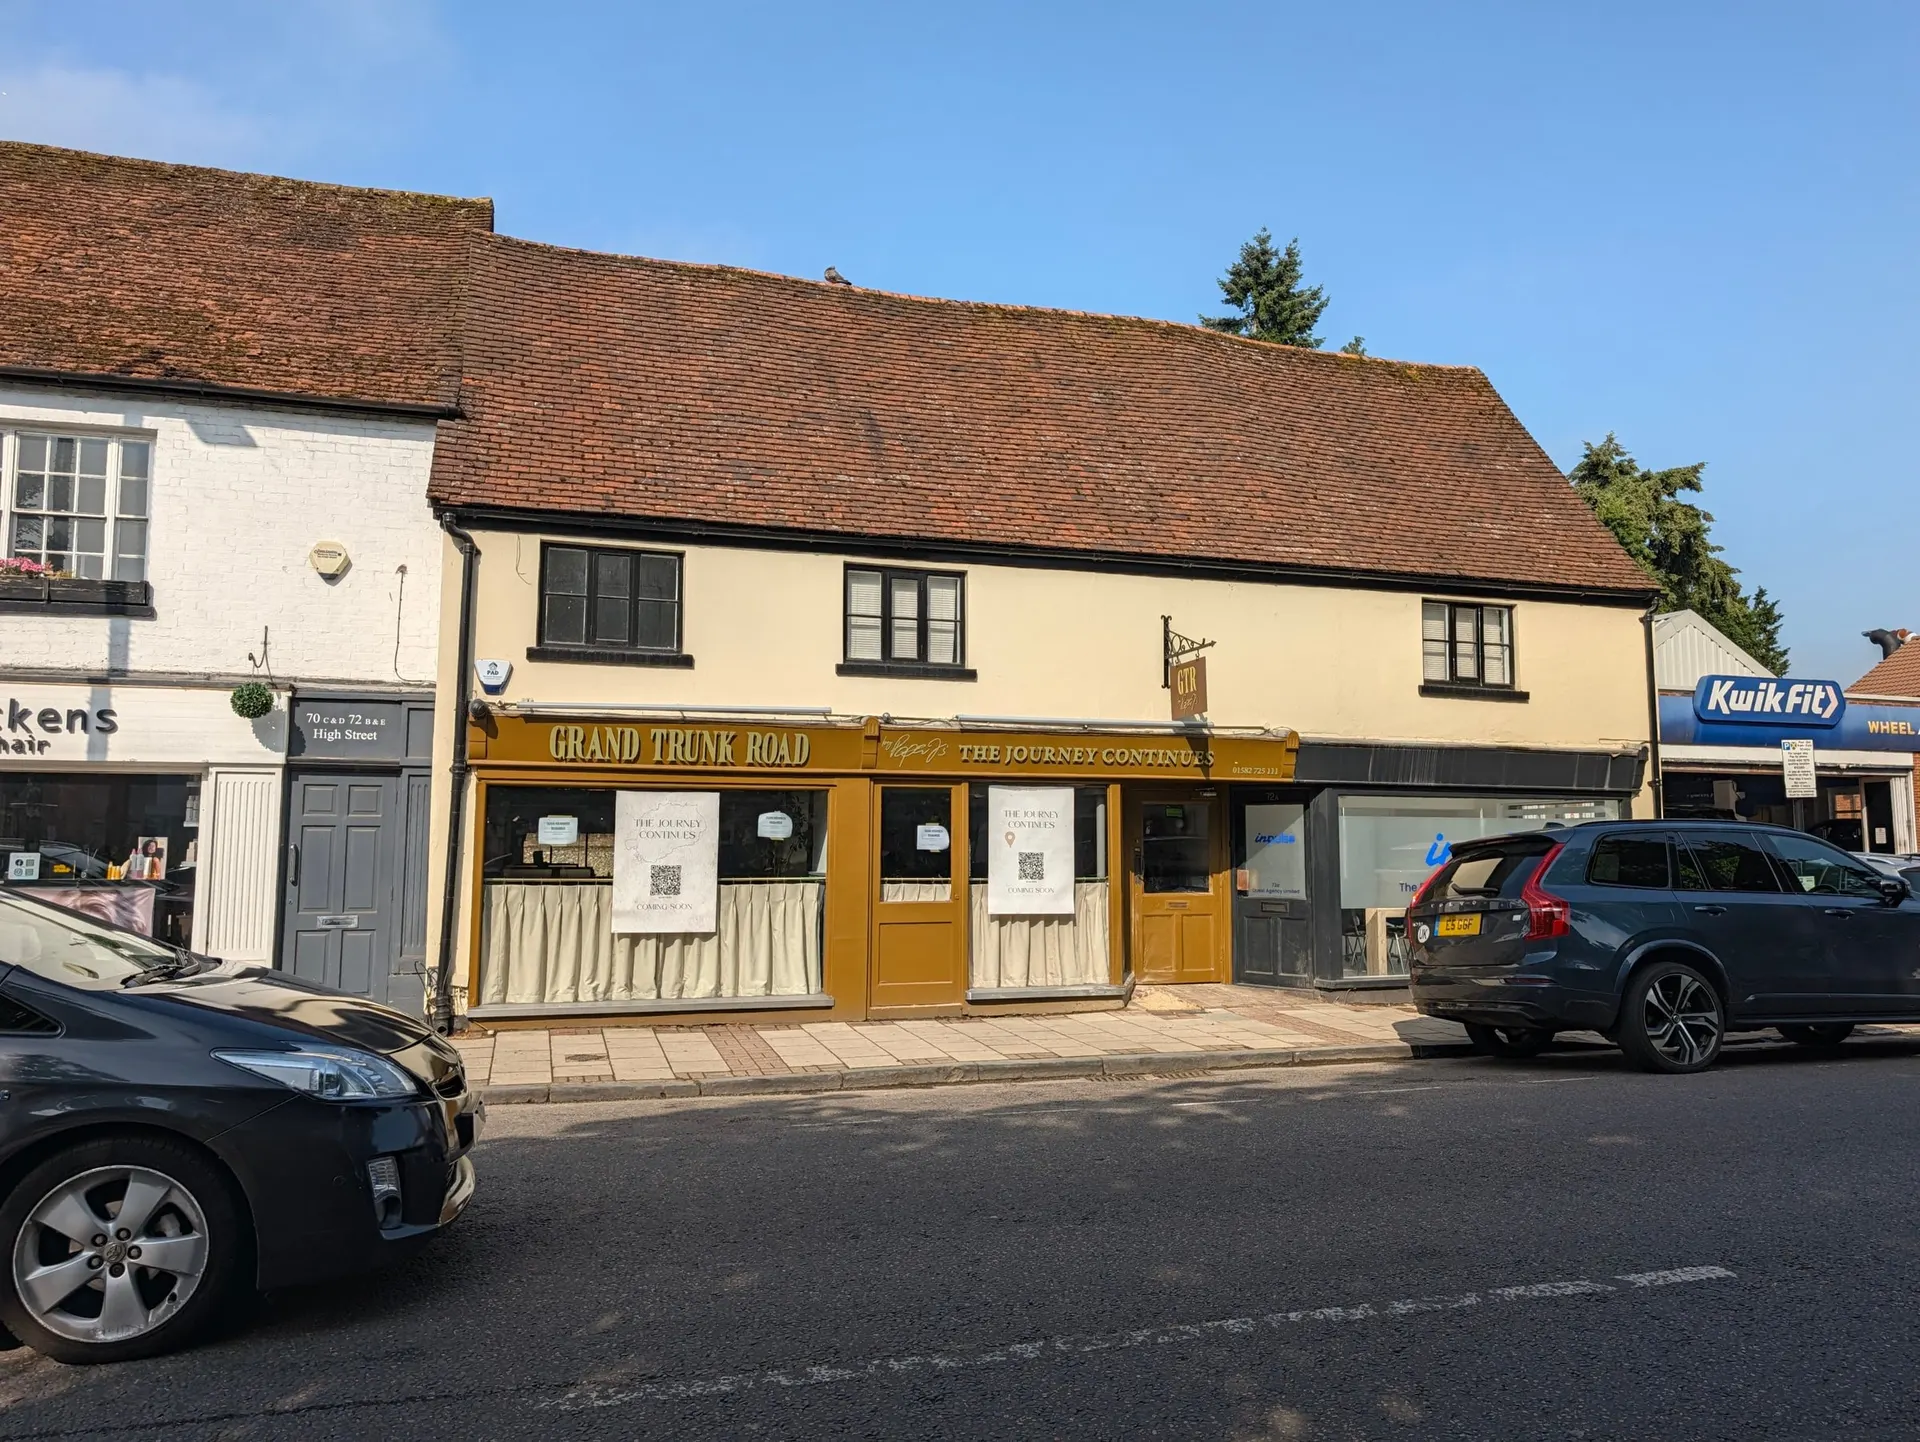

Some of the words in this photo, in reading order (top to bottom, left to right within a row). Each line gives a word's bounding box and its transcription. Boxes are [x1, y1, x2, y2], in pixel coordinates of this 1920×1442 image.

[1177, 666, 1197, 695] GTR
[0, 698, 119, 734] kens
[306, 712, 321, 724] 70
[348, 714, 362, 725] 72
[1867, 720, 1916, 735] WHEEL
[313, 728, 341, 742] High
[344, 729, 378, 741] Street
[549, 725, 641, 763] GRAND
[650, 728, 737, 766] TRUNK
[745, 731, 811, 768] ROAD
[958, 744, 1001, 764] THE
[1004, 745, 1098, 766] JOURNEY
[1101, 748, 1215, 768] CONTINUES
[1232, 766, 1253, 774] 01582
[1003, 810, 1021, 818] THE
[1023, 810, 1059, 819] JOURNEY
[633, 819, 655, 828] THE
[658, 819, 701, 828] JOURNEY
[1008, 820, 1056, 829] CONTINUES
[639, 831, 696, 840] CONTINUES
[1399, 883, 1417, 892] The
